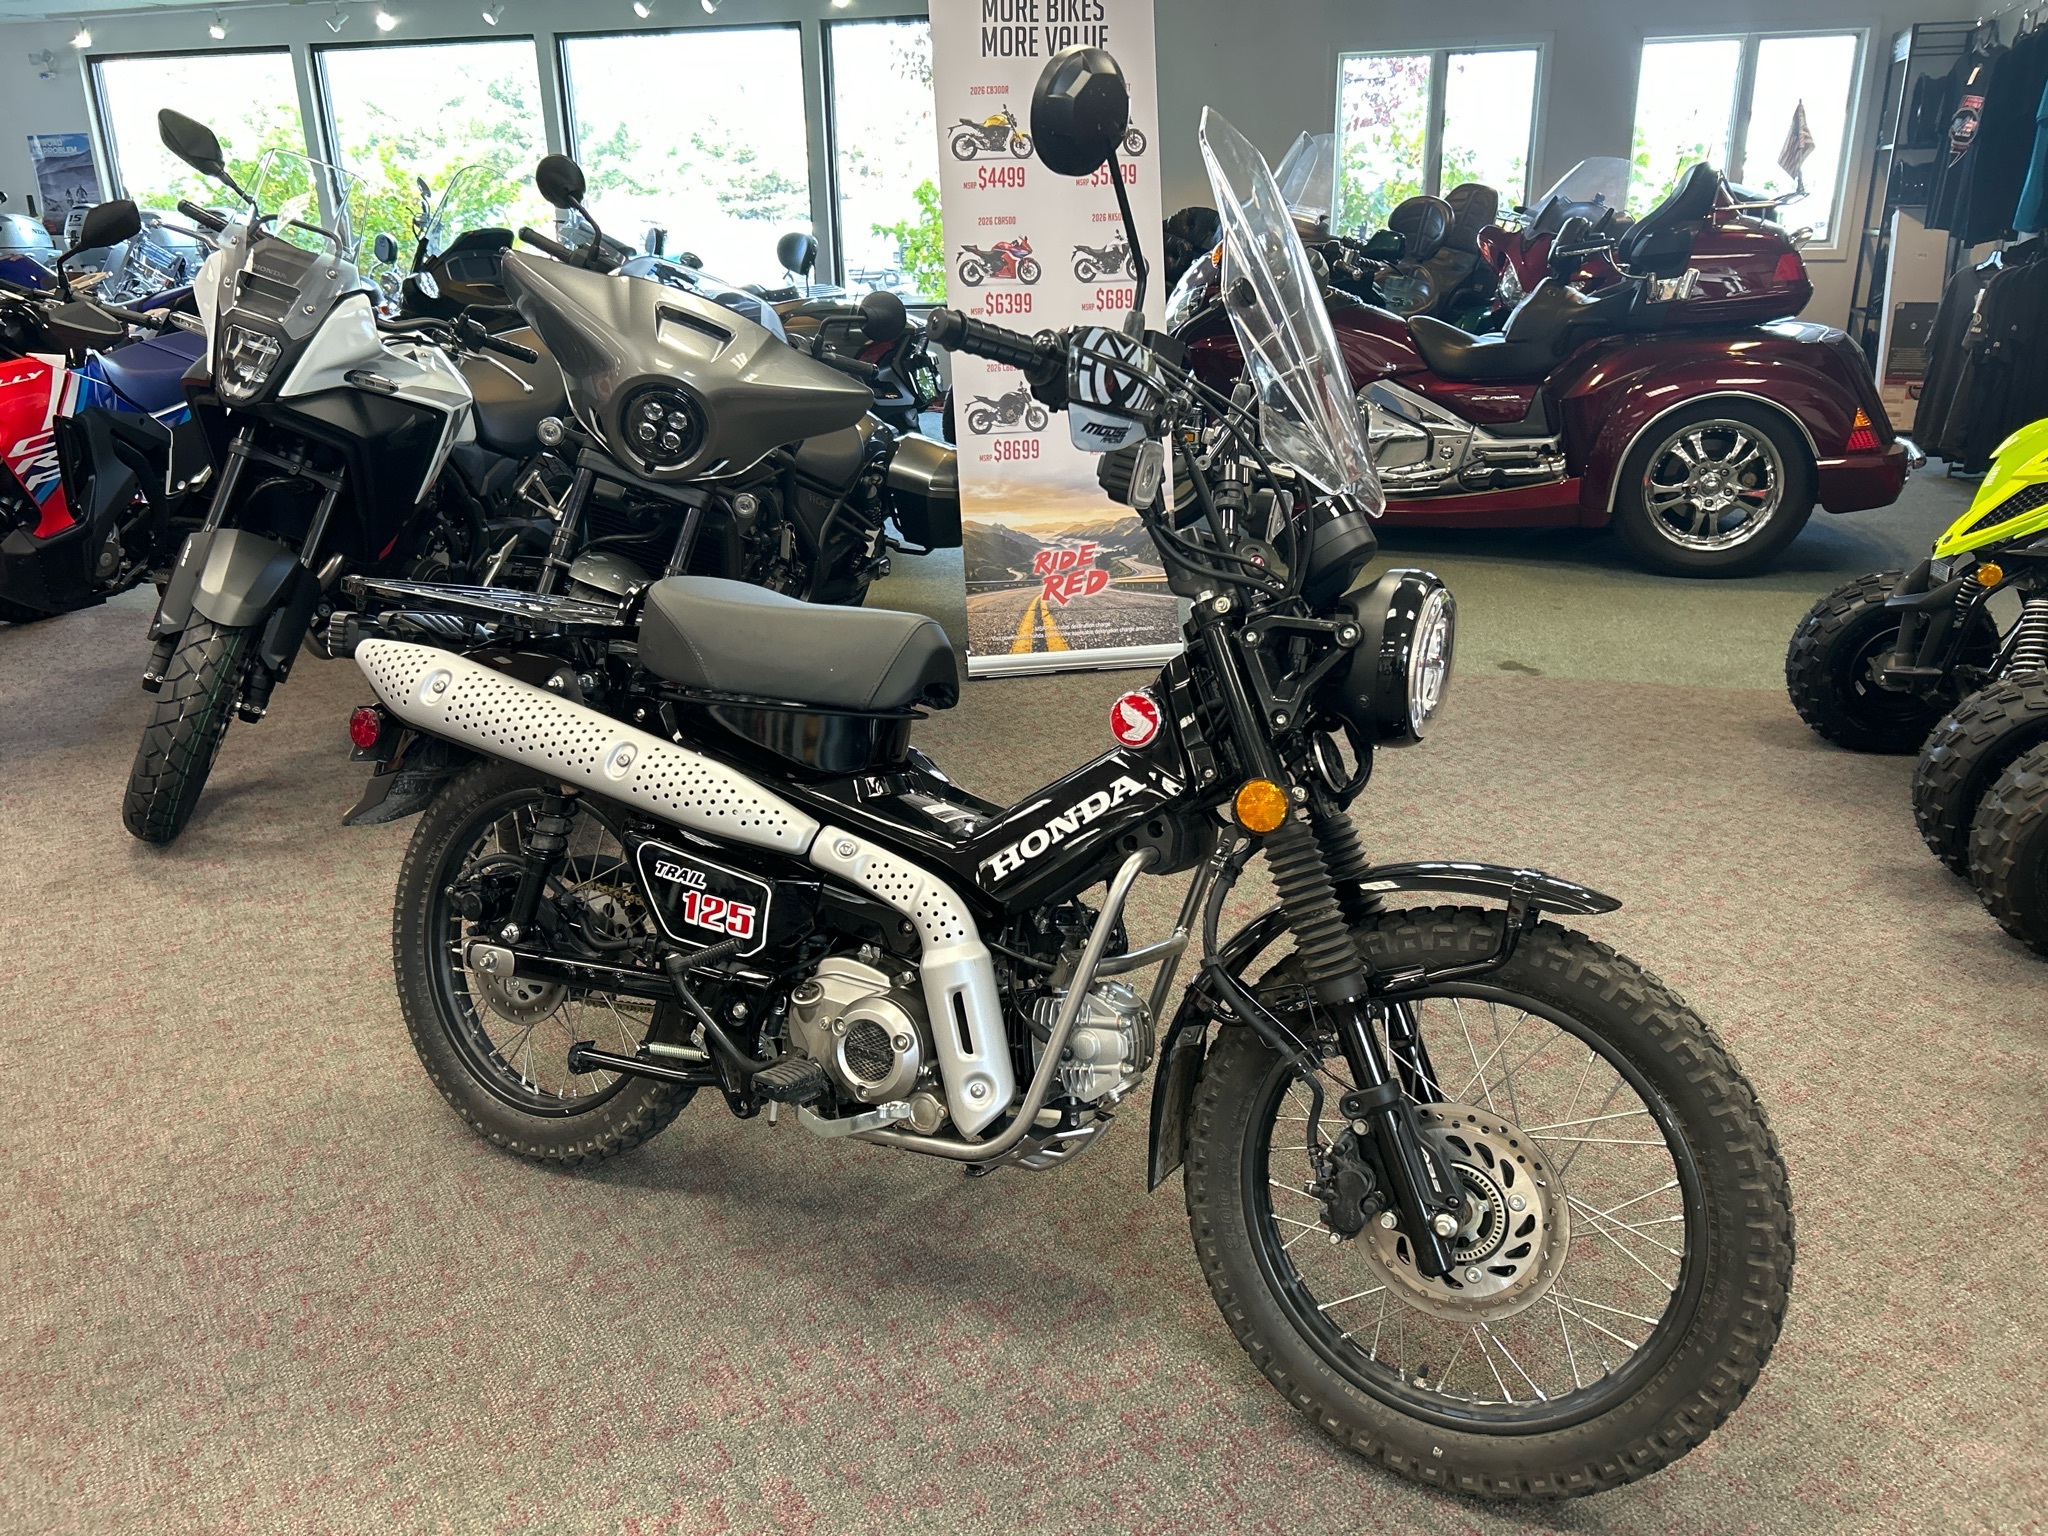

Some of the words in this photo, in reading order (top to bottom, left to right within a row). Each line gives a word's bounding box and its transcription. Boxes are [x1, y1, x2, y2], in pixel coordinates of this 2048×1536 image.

[982, 0, 1039, 23] MORE
[1047, 0, 1105, 22] BIKES
[982, 26, 1039, 57] MORE
[970, 86, 985, 95] 2026
[986, 85, 1009, 95] CB300R
[963, 181, 977, 189] MSRP
[979, 166, 1025, 190] $4499
[1076, 178, 1089, 187] MSRP
[1091, 164, 1137, 187] $599
[978, 216, 993, 226] 2026
[1092, 213, 1106, 222] 2026
[1108, 213, 1123, 221] NX50
[253, 263, 288, 280] HONDA
[971, 307, 984, 315] MSRP
[986, 292, 1032, 316] $6399
[1096, 288, 1133, 312] $689
[987, 364, 1001, 372] 2026
[994, 439, 1039, 463] $8699
[1033, 542, 1097, 576] RIDE
[1042, 568, 1109, 606] RED
[987, 775, 1147, 882] HONDA
[655, 860, 707, 890] TRAIL
[682, 890, 756, 940] 125
